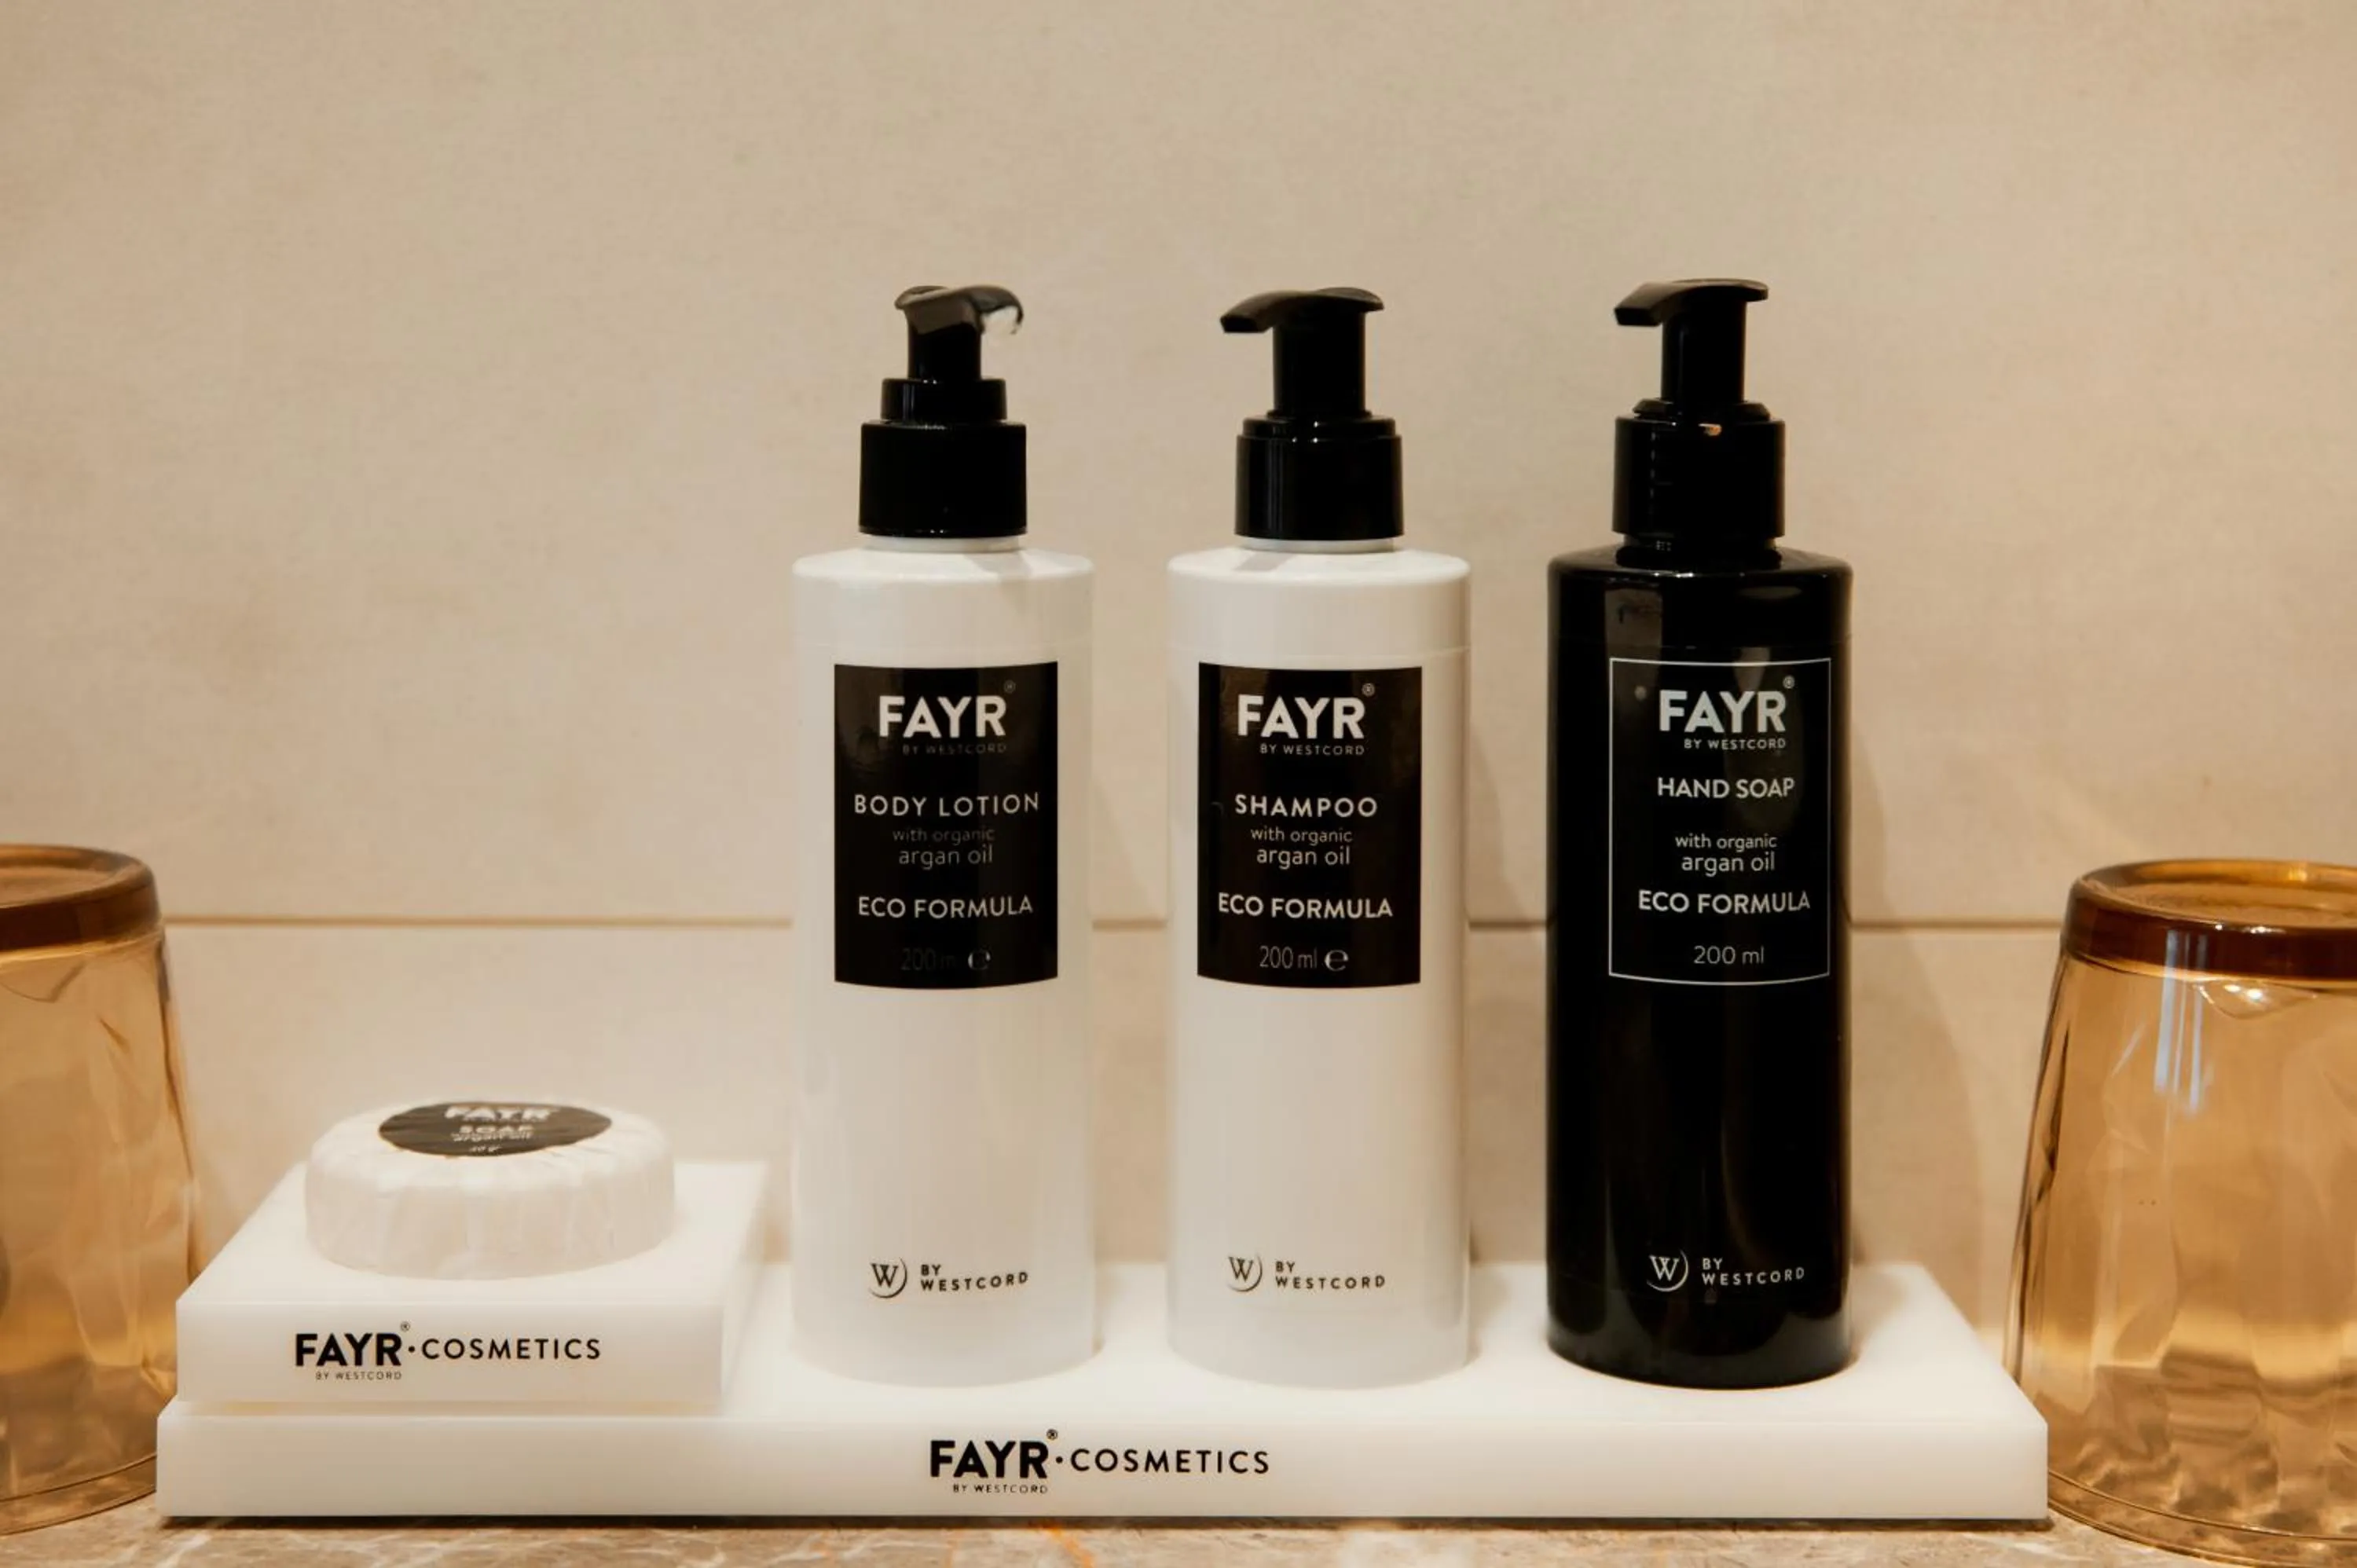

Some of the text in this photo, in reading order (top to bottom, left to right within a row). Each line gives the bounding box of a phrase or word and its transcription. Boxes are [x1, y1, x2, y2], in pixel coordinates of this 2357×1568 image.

[878, 695, 1007, 739] FAYR
[1237, 694, 1365, 739] FAYR
[1659, 690, 1787, 734] FAYR
[1259, 743, 1365, 756] BY WESTCORD
[1684, 737, 1787, 750] BY WESTCORD
[1657, 776, 1796, 799] HAND SOAP
[853, 791, 1039, 817] BODY LOTION
[1234, 793, 1378, 818] SHAMPOO
[892, 828, 995, 846] with organic
[1250, 826, 1353, 847] with organic
[1675, 832, 1777, 852] with organic
[898, 844, 994, 870] argan oil
[1256, 845, 1351, 870] argan oil
[1681, 851, 1776, 877] argan oil
[858, 895, 1034, 919] ECO FORMULA
[1218, 892, 1394, 920] ECO FORMULA
[1638, 888, 1811, 914] ECO FORMULA
[900, 947, 937, 972] 200
[1259, 944, 1294, 969] 200
[1297, 947, 1318, 970] ml
[1693, 945, 1765, 965] 200 ml
[920, 1264, 941, 1277] BY
[1275, 1260, 1296, 1273] BY
[1702, 1257, 1723, 1271] BY
[920, 1271, 1029, 1292] WESTCORD
[1275, 1274, 1386, 1290] WESTCORD
[1701, 1266, 1805, 1287] WESTCORD
[295, 1332, 602, 1367] FAYR COSMETICS
[315, 1370, 402, 1381] BY WESTCORD
[929, 1439, 1270, 1479] FAYR COSMETICS
[952, 1484, 1049, 1494] BY WESTCORD
